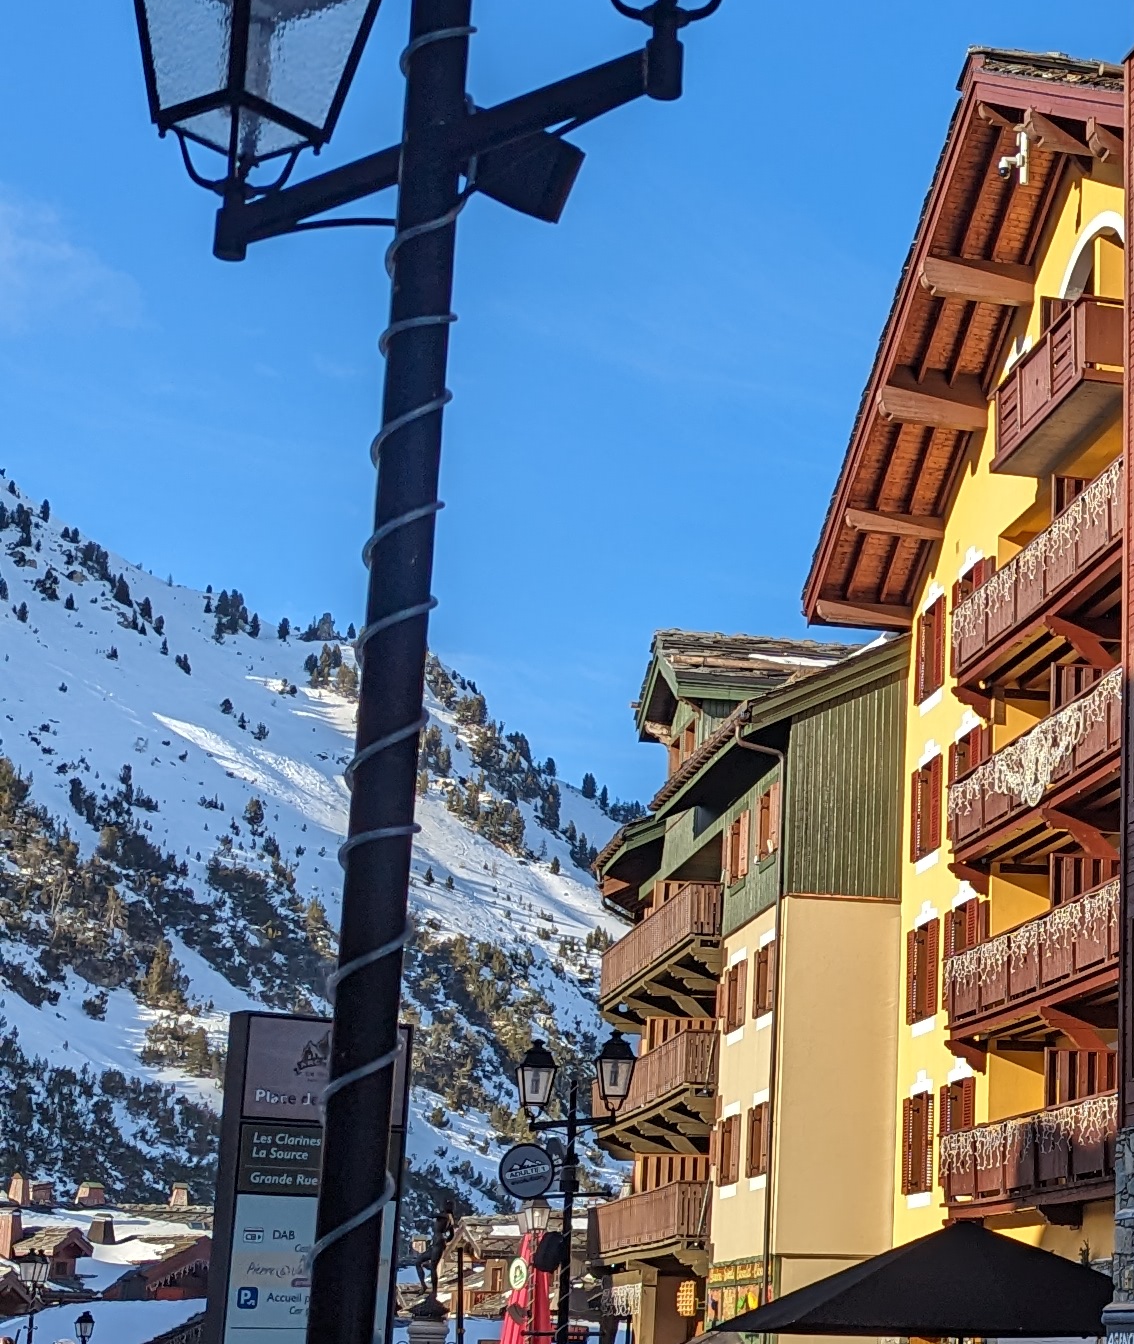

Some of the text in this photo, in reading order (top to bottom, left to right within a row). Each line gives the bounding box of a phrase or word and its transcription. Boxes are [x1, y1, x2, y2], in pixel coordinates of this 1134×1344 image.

[255, 1089, 297, 1105] Place
[253, 1132, 321, 1147] Les Clarines
[252, 1147, 308, 1160] La Source
[250, 1172, 319, 1186] Grande Rue
[272, 1229, 296, 1240] DAB
[266, 1292, 302, 1303] Accueil
